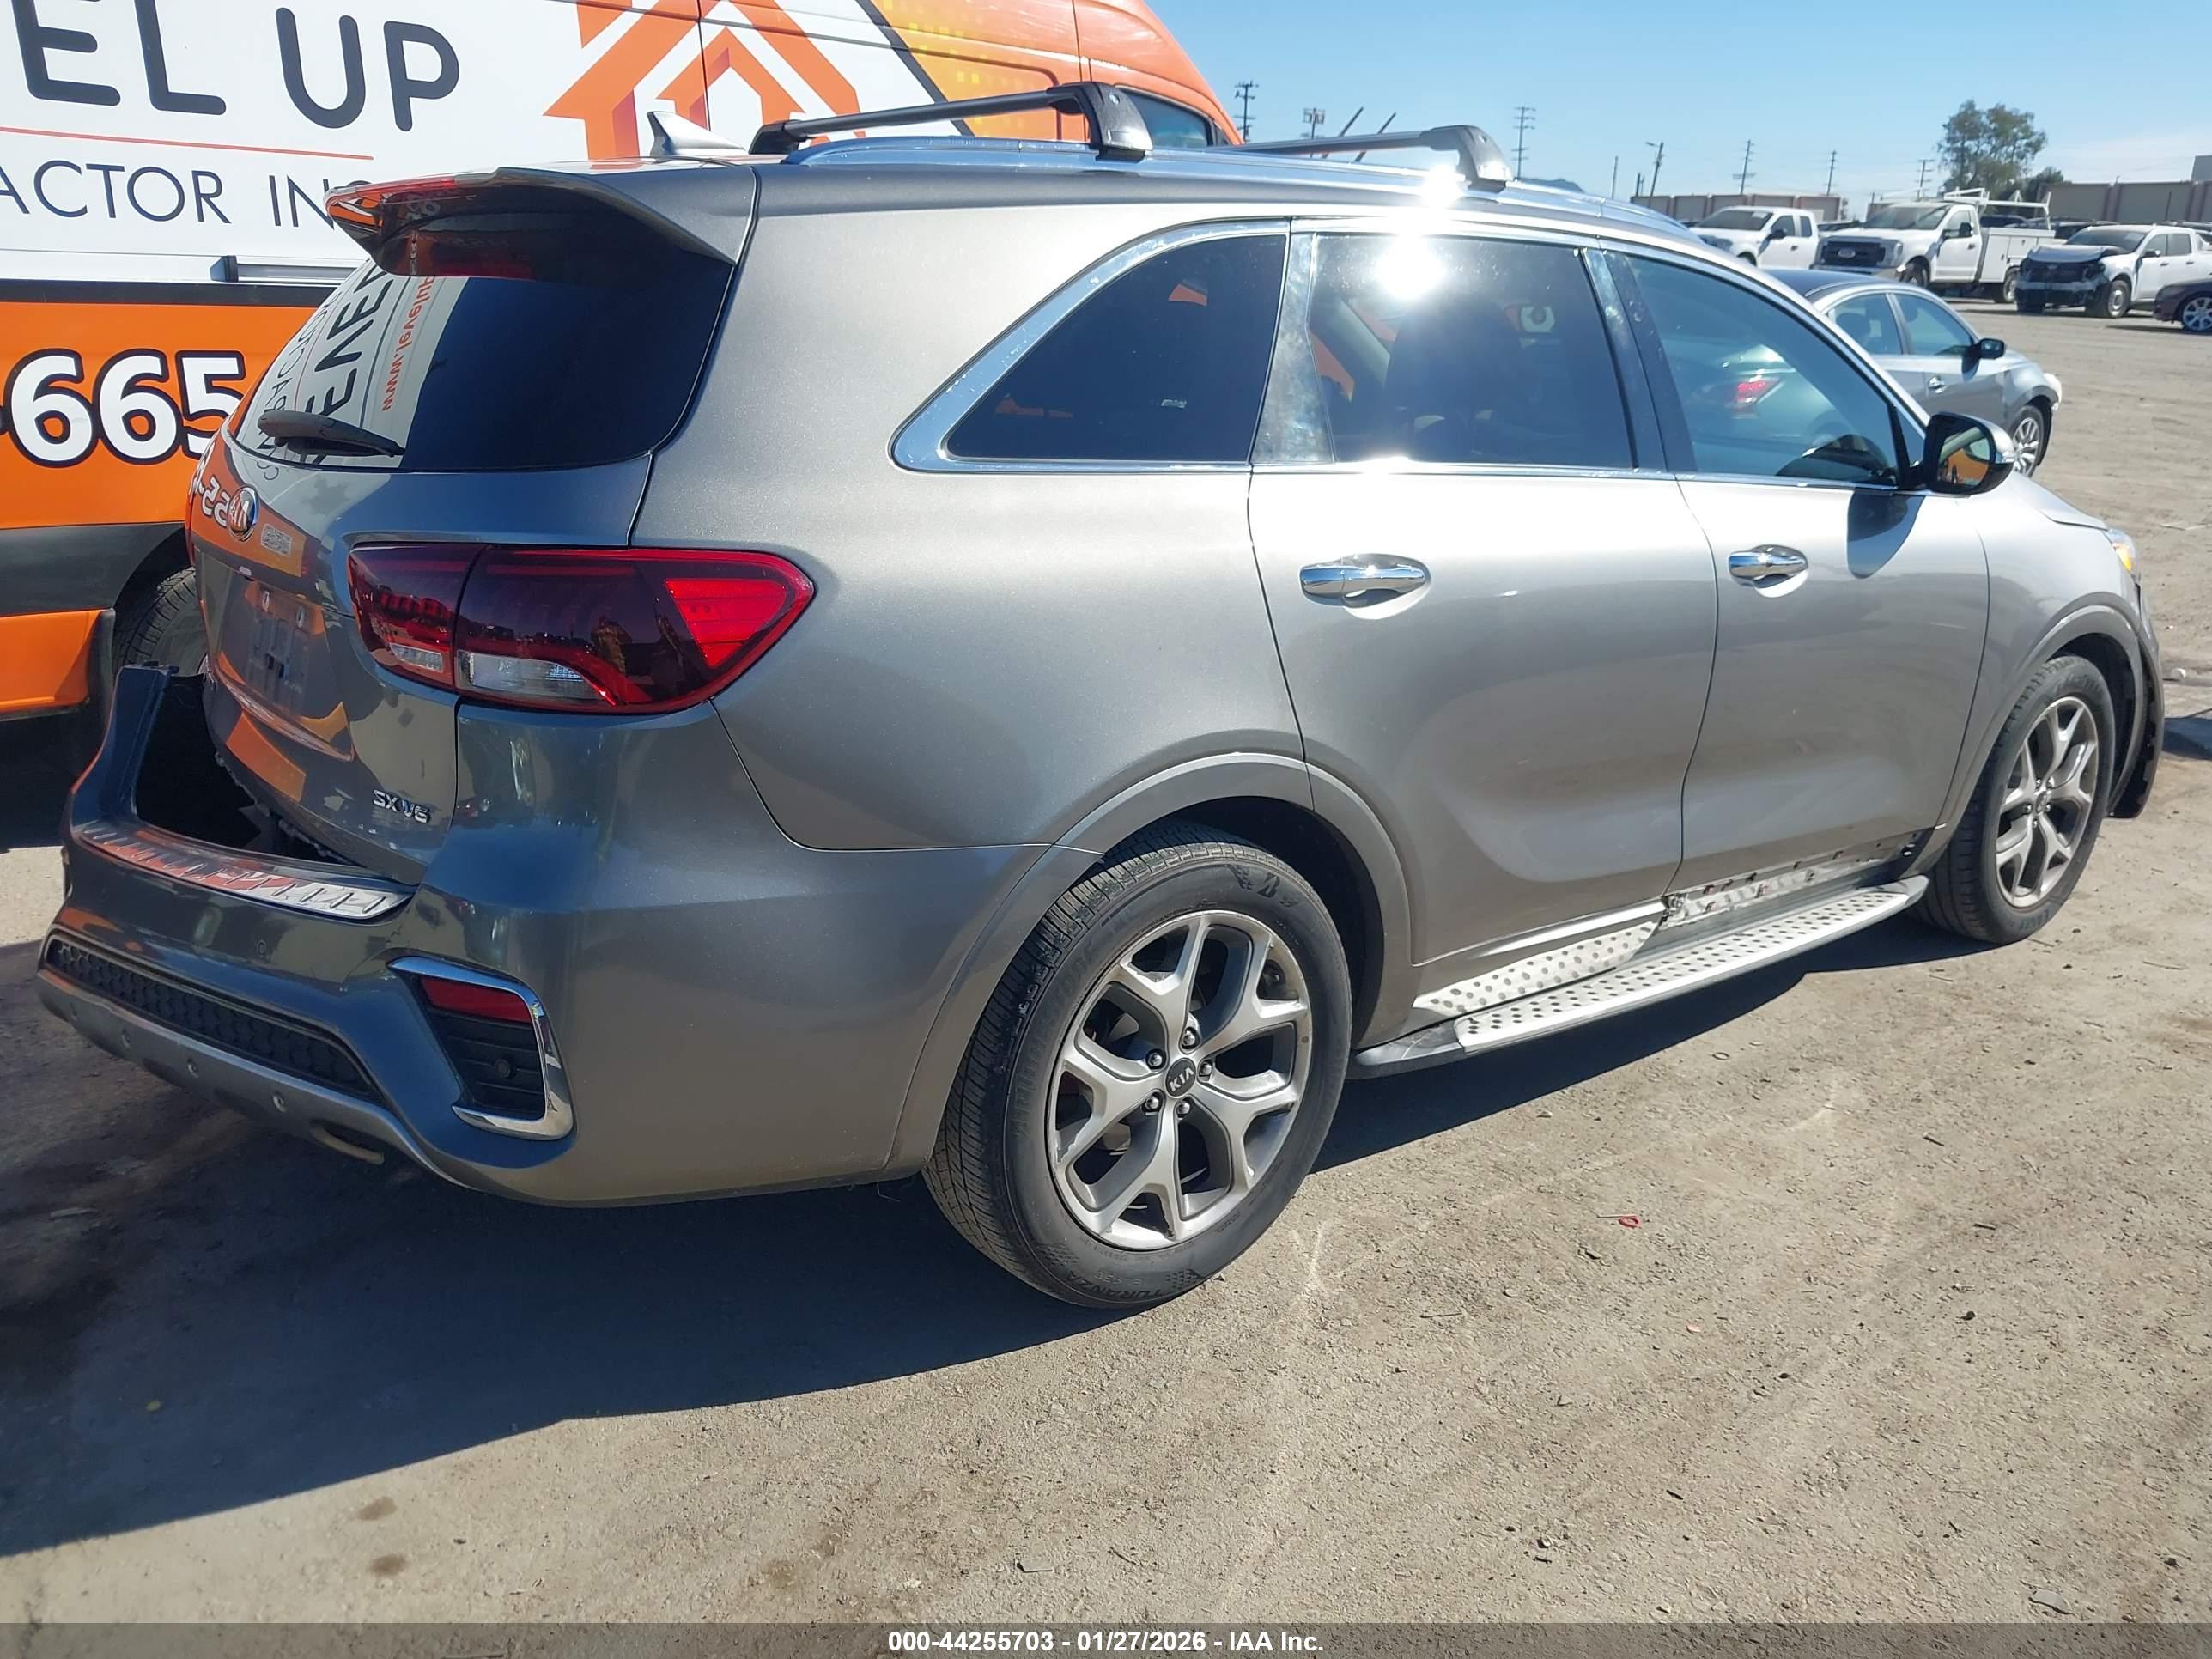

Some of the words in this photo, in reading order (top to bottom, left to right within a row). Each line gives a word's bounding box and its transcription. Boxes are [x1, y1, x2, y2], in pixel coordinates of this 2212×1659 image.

[276, 7, 460, 132] UP
[269, 174, 372, 230] IN
[373, 789, 398, 812] SX
[401, 799, 428, 823] V6
[1169, 1066, 1194, 1092] KIA
